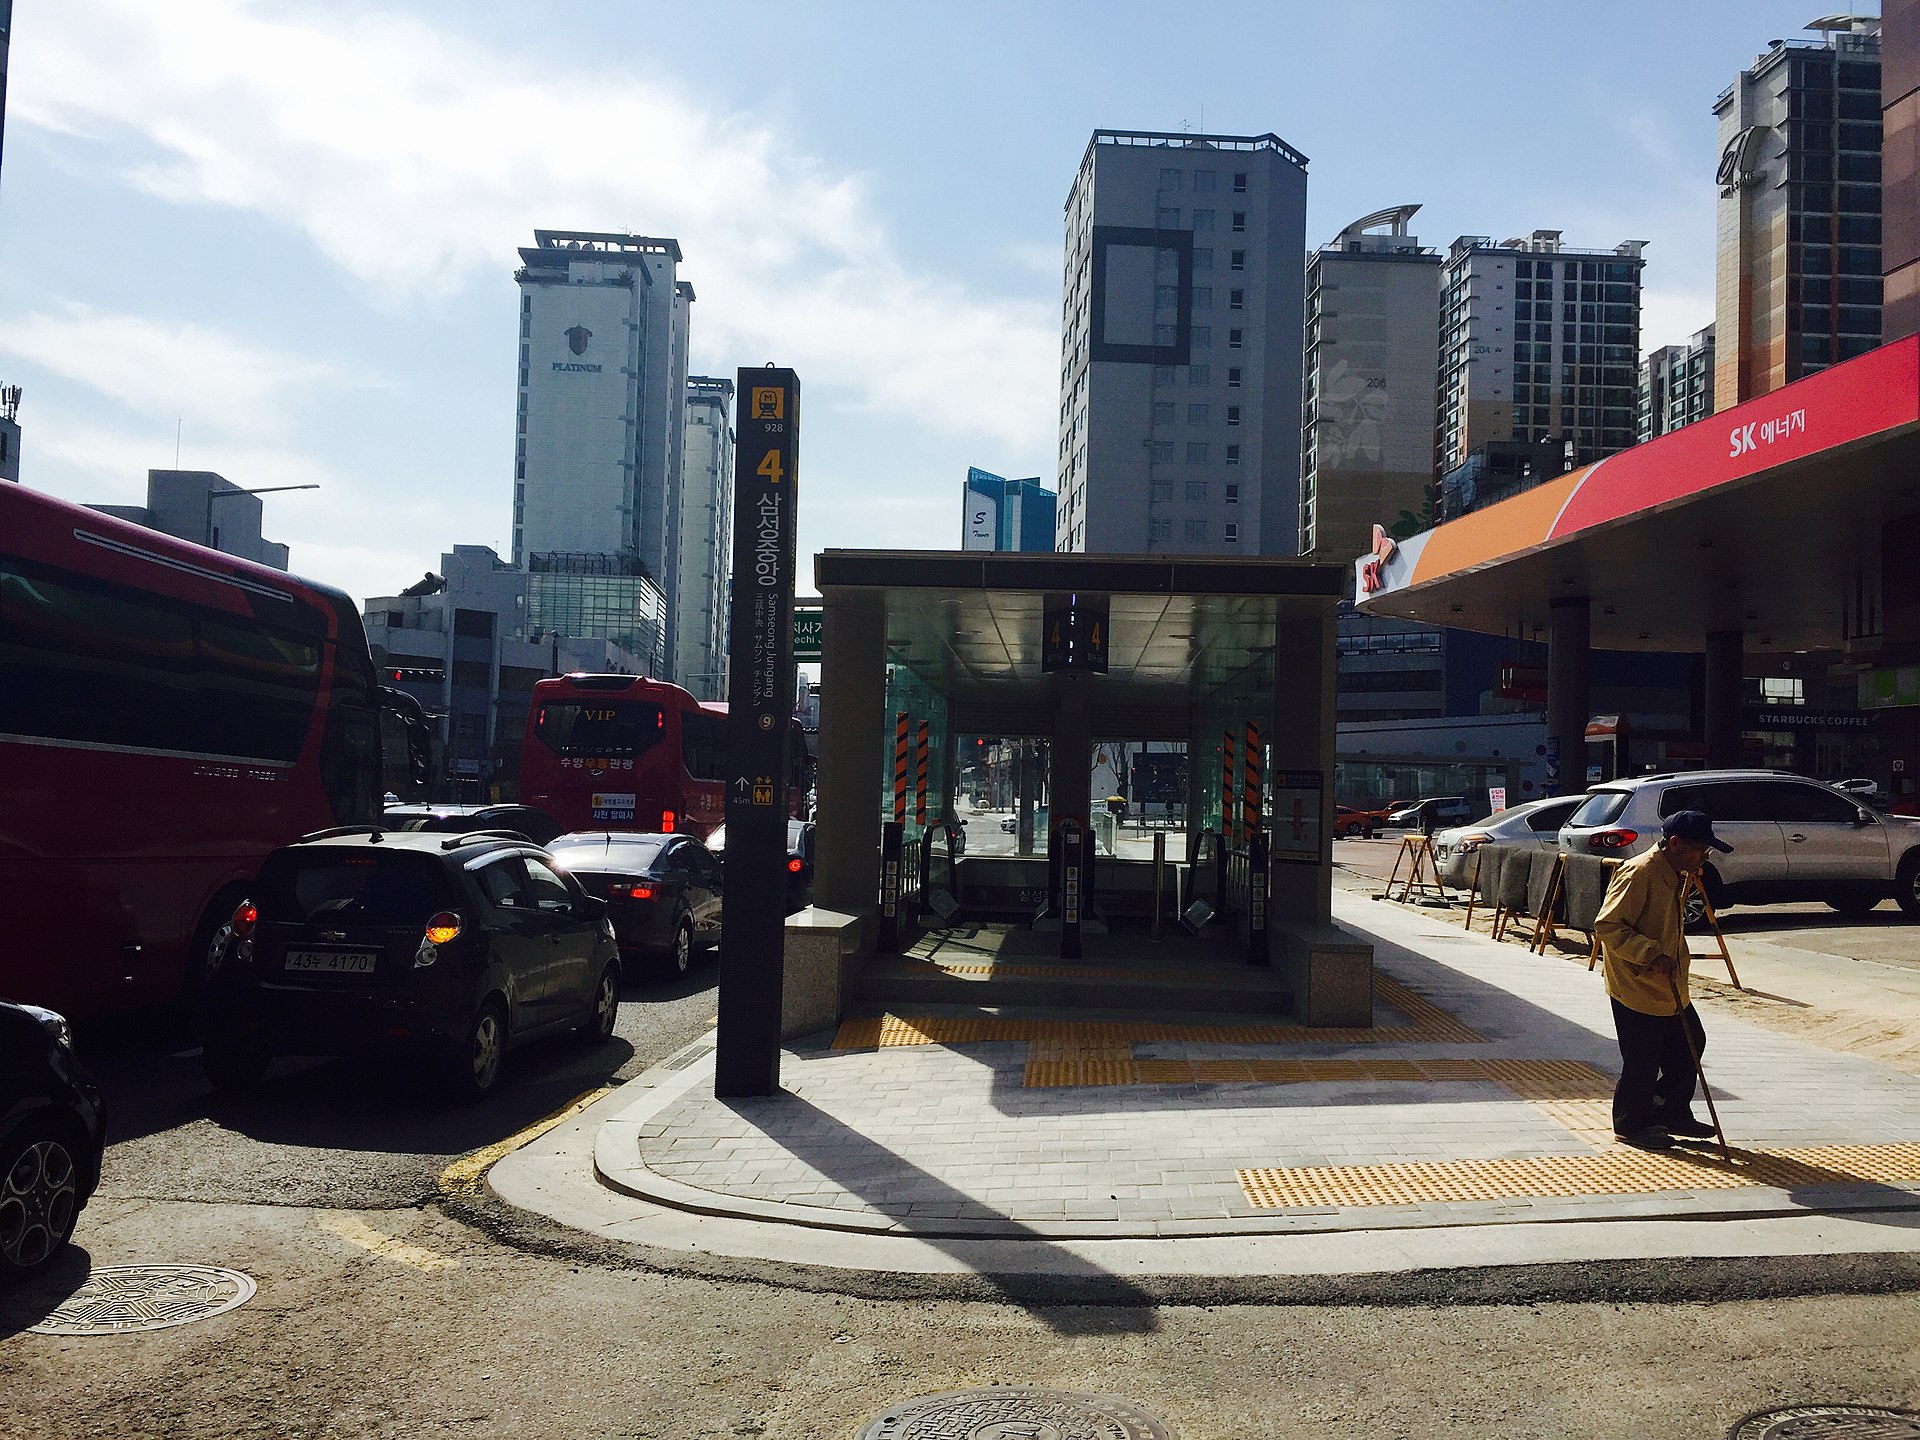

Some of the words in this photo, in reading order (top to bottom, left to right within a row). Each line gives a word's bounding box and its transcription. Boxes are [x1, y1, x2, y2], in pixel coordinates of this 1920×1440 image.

[1474, 345, 1490, 354] 204
[551, 361, 603, 374] PLATINUM
[1366, 377, 1387, 389] 206
[764, 422, 784, 433] 928
[1729, 421, 1757, 458] SK
[1760, 408, 1806, 445] 에너지
[756, 448, 784, 484] 4
[972, 511, 987, 526] S
[755, 491, 782, 587] 삼성중앙
[1362, 558, 1381, 593] SK
[764, 593, 778, 649] Samseong
[1051, 620, 1062, 649] 4
[1091, 622, 1102, 651] 4
[763, 650, 777, 699] Jungang
[584, 709, 616, 721] VIP
[763, 716, 771, 728] 9
[1758, 713, 1826, 725] STARBUCKS
[1827, 715, 1869, 726] COFFEE
[732, 796, 751, 805] 45m
[292, 952, 322, 968] 43누
[328, 954, 369, 971] 4170
